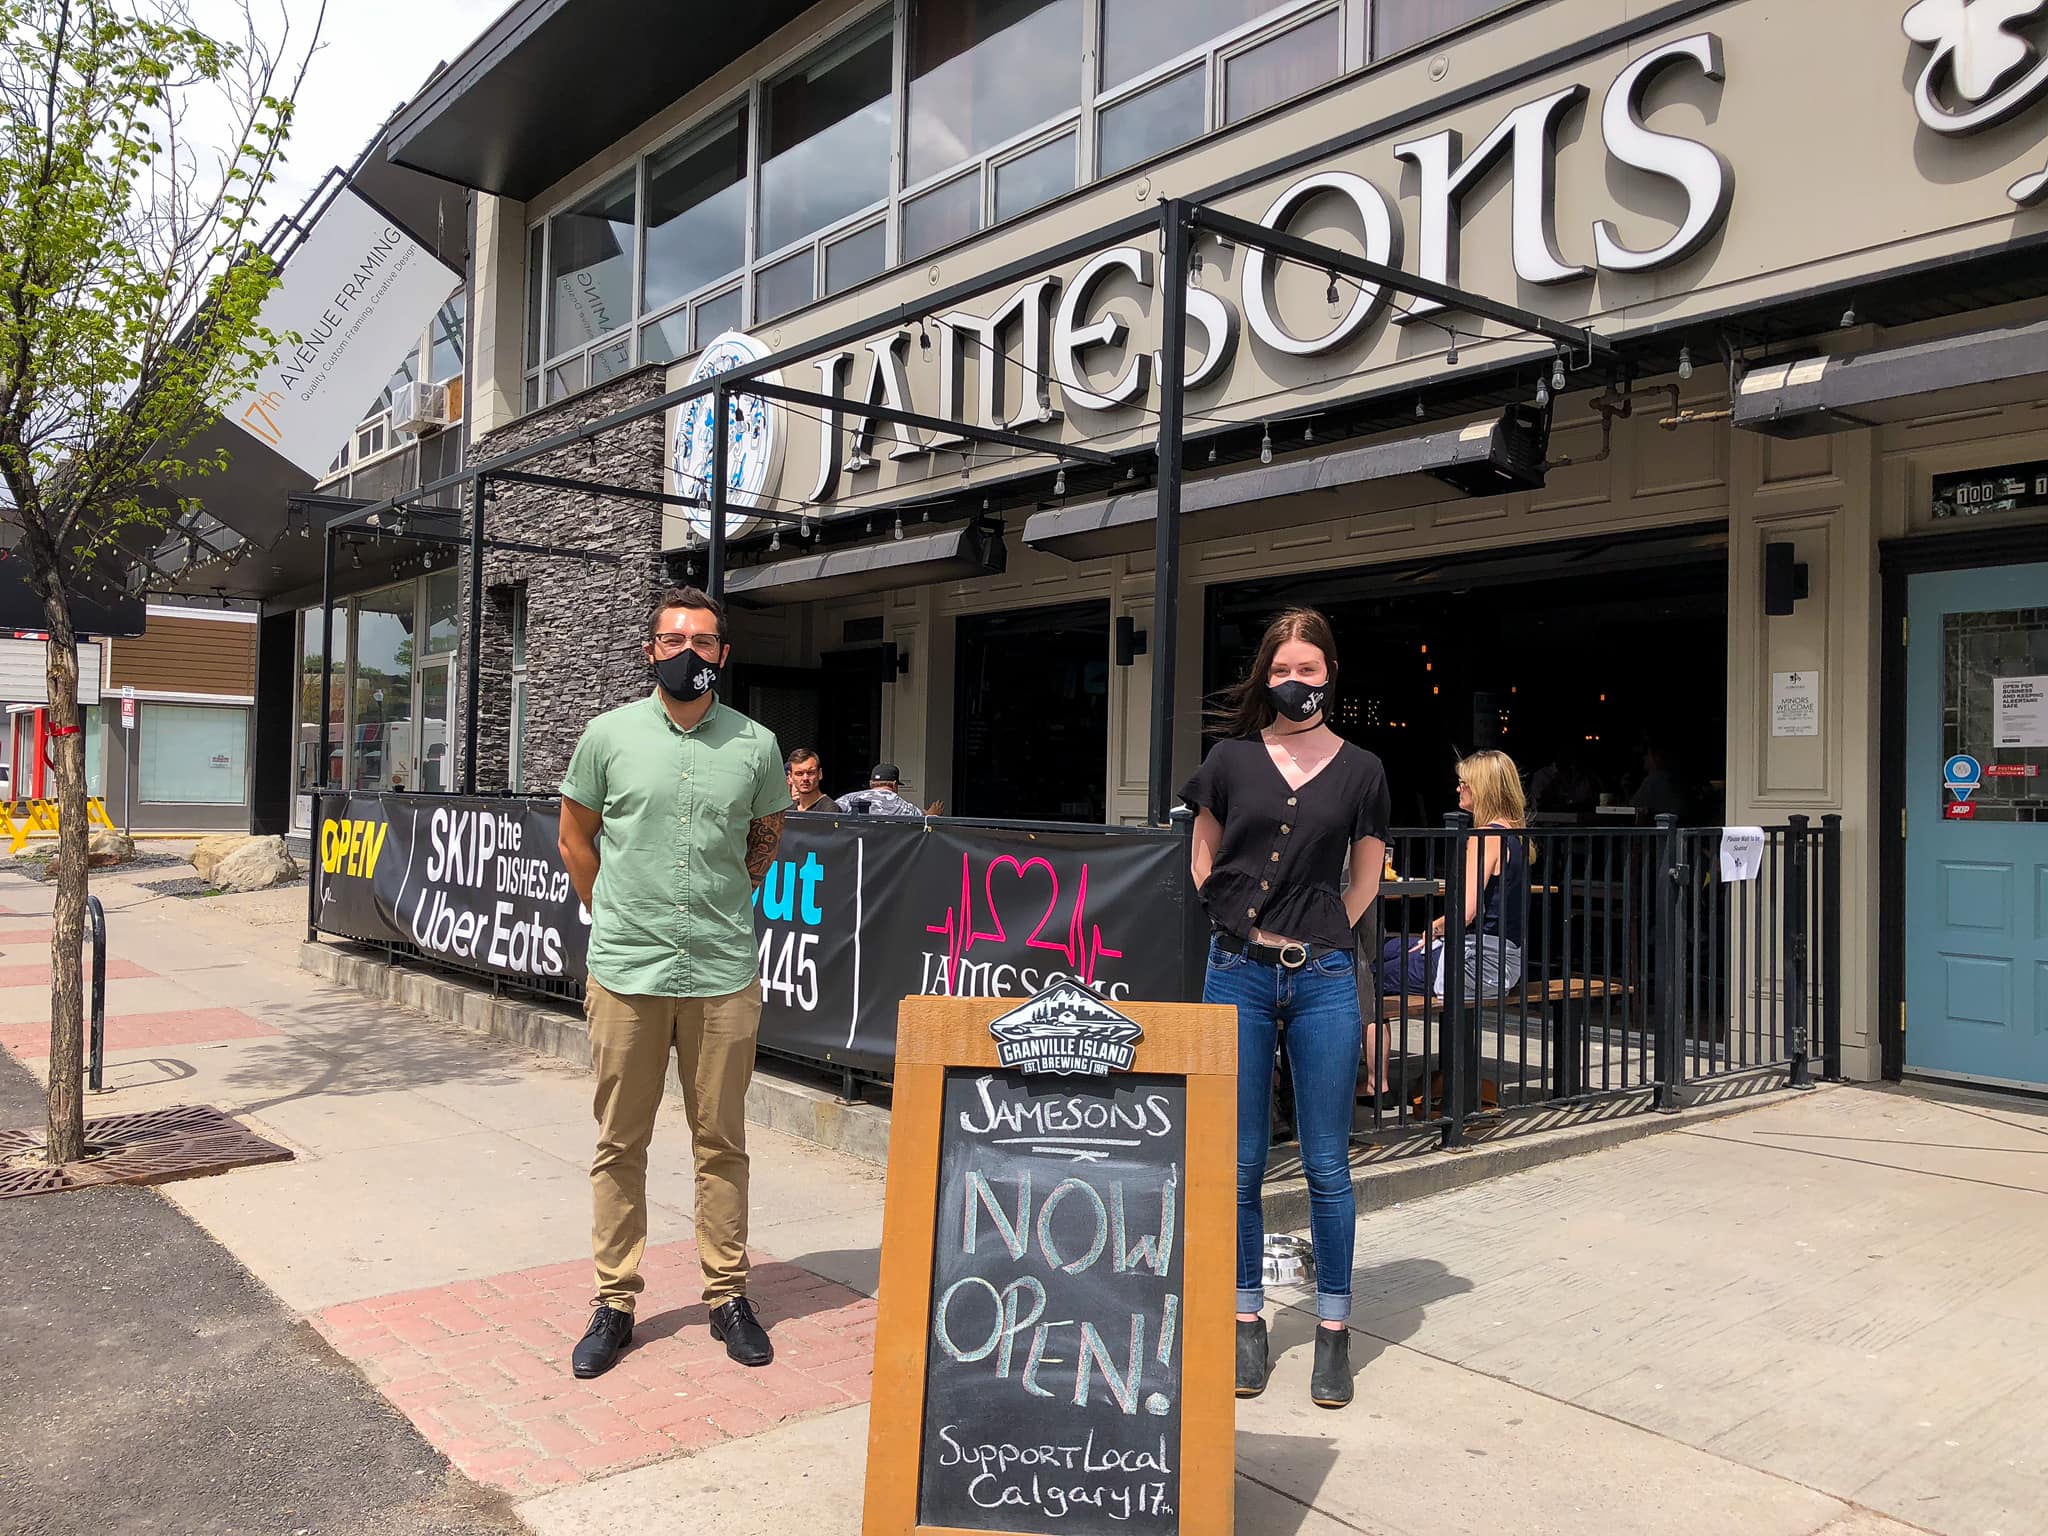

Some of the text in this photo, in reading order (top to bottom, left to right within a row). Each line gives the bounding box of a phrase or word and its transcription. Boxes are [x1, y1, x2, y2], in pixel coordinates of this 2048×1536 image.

[810, 32, 1735, 502] JAMESONS
[241, 227, 401, 445] 17th AVENUE FRAMING
[301, 244, 416, 401] Quality Custom Framing, Creative Design
[1957, 484, 1993, 504] 100
[1777, 703, 1813, 711] WELCOME
[1952, 805, 1970, 813] SKIP
[321, 818, 388, 879] OPEN
[427, 807, 522, 888] SKIP the
[496, 855, 570, 903] DISHES.ca
[752, 852, 824, 925] ut
[412, 888, 563, 976] Uber Eats
[1003, 1038, 1129, 1064] GRANVILLE ISLAND
[1024, 1063, 1037, 1073] EST.
[1042, 1057, 1088, 1070] BREWING
[959, 1074, 1171, 1137] JAMESONS
[963, 1165, 1177, 1277] NOW
[935, 1275, 1178, 1415] OPEN!
[968, 1472, 1174, 1520] Calgary 17th
